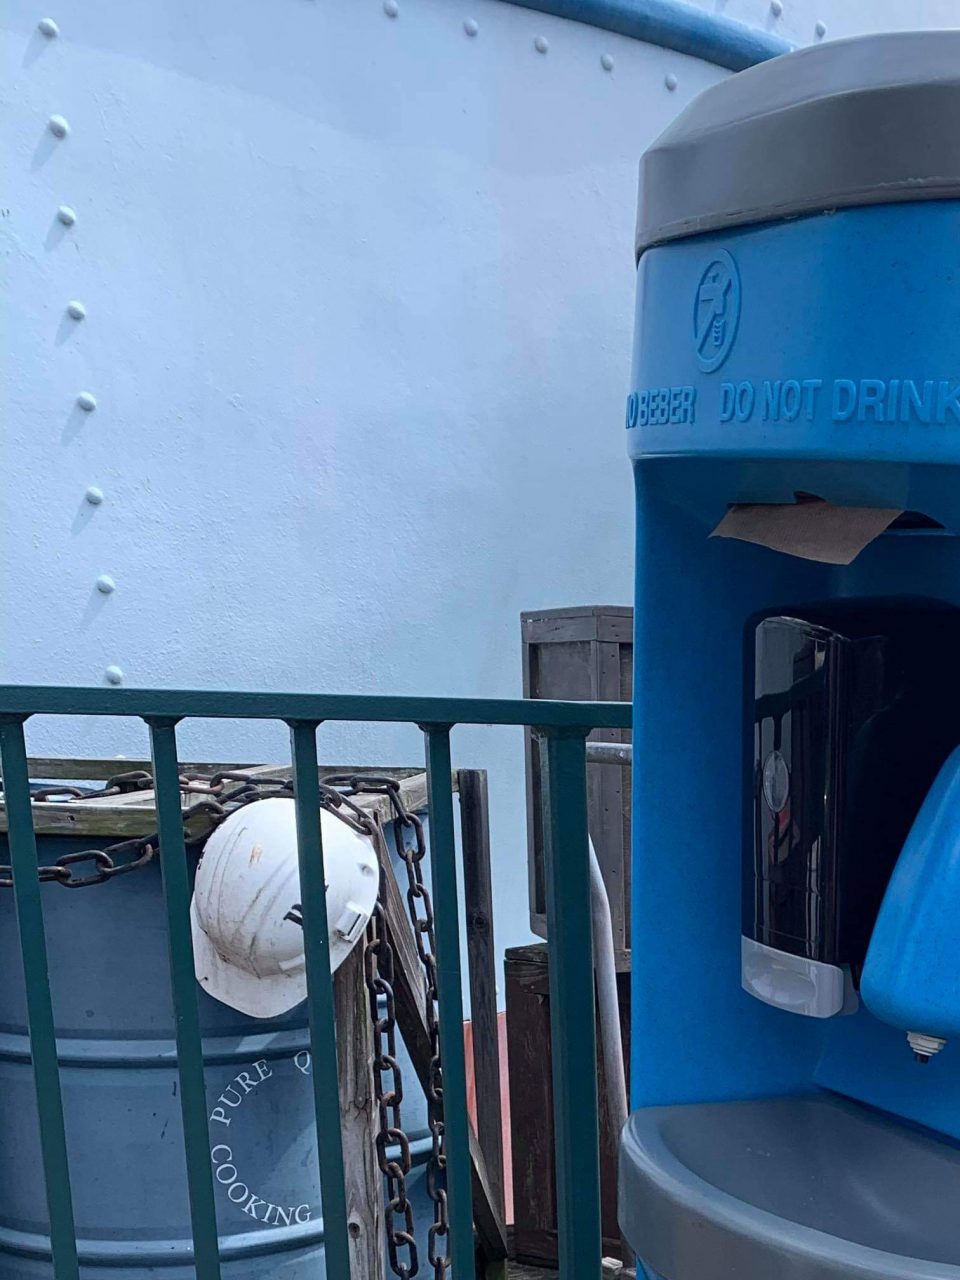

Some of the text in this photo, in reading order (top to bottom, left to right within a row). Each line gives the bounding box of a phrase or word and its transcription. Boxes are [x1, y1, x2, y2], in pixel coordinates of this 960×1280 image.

[626, 386, 697, 429] O BEBER
[719, 380, 754, 422] DO
[762, 378, 822, 422] NOT
[210, 1059, 273, 1126] PURE
[211, 1144, 312, 1226] COOKING
